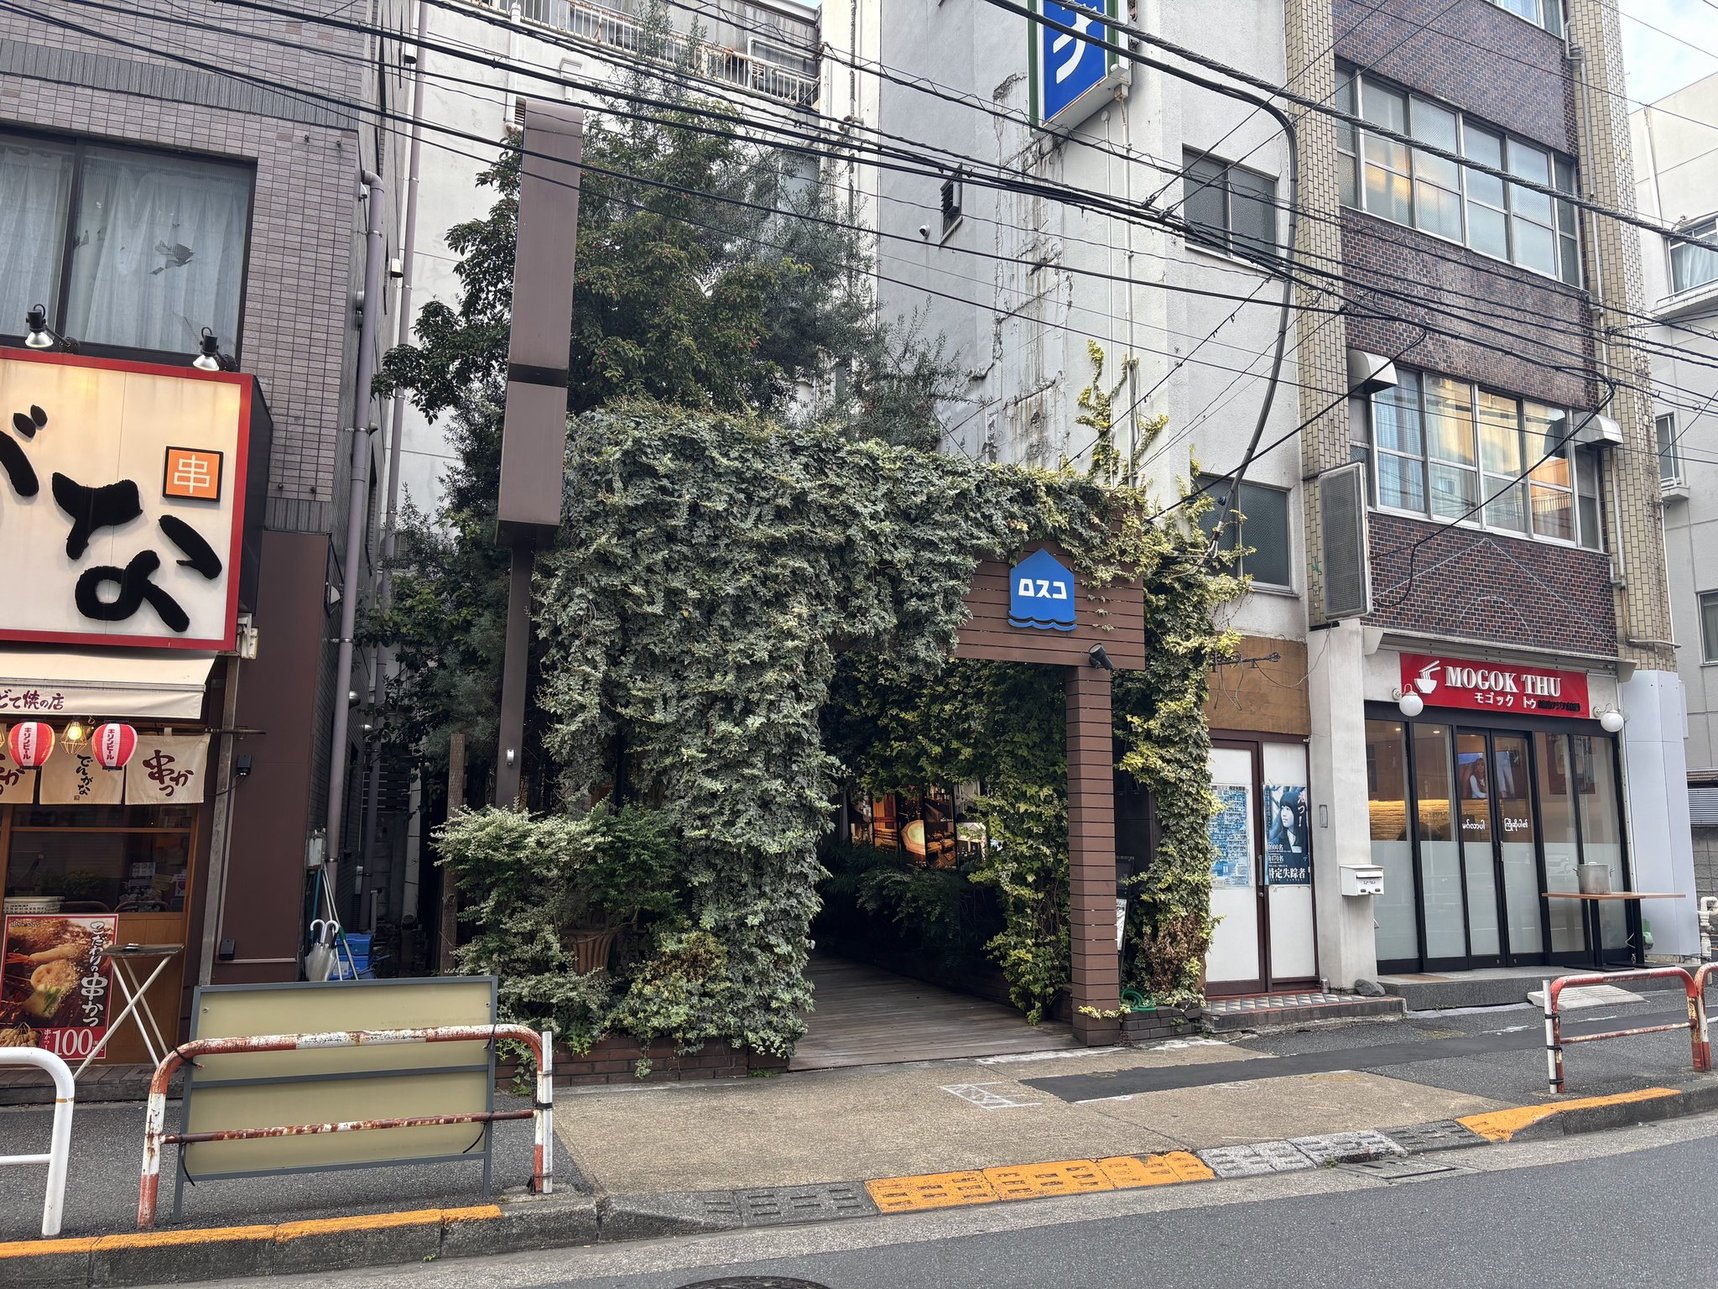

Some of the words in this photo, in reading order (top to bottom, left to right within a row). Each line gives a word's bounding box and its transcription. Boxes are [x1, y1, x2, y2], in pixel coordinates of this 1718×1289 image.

[173, 453, 211, 495] 串
[1017, 577, 1068, 600] ロスコ
[1444, 665, 1518, 694] MOGOK
[1521, 674, 1562, 698] THU
[1474, 691, 1514, 707] モゴック
[22, 727, 32, 760] キリンビール
[106, 728, 116, 761] キリンビール
[76, 753, 94, 796] でんがな
[142, 749, 195, 797] 串かつ
[52, 1028, 93, 1056] 100
